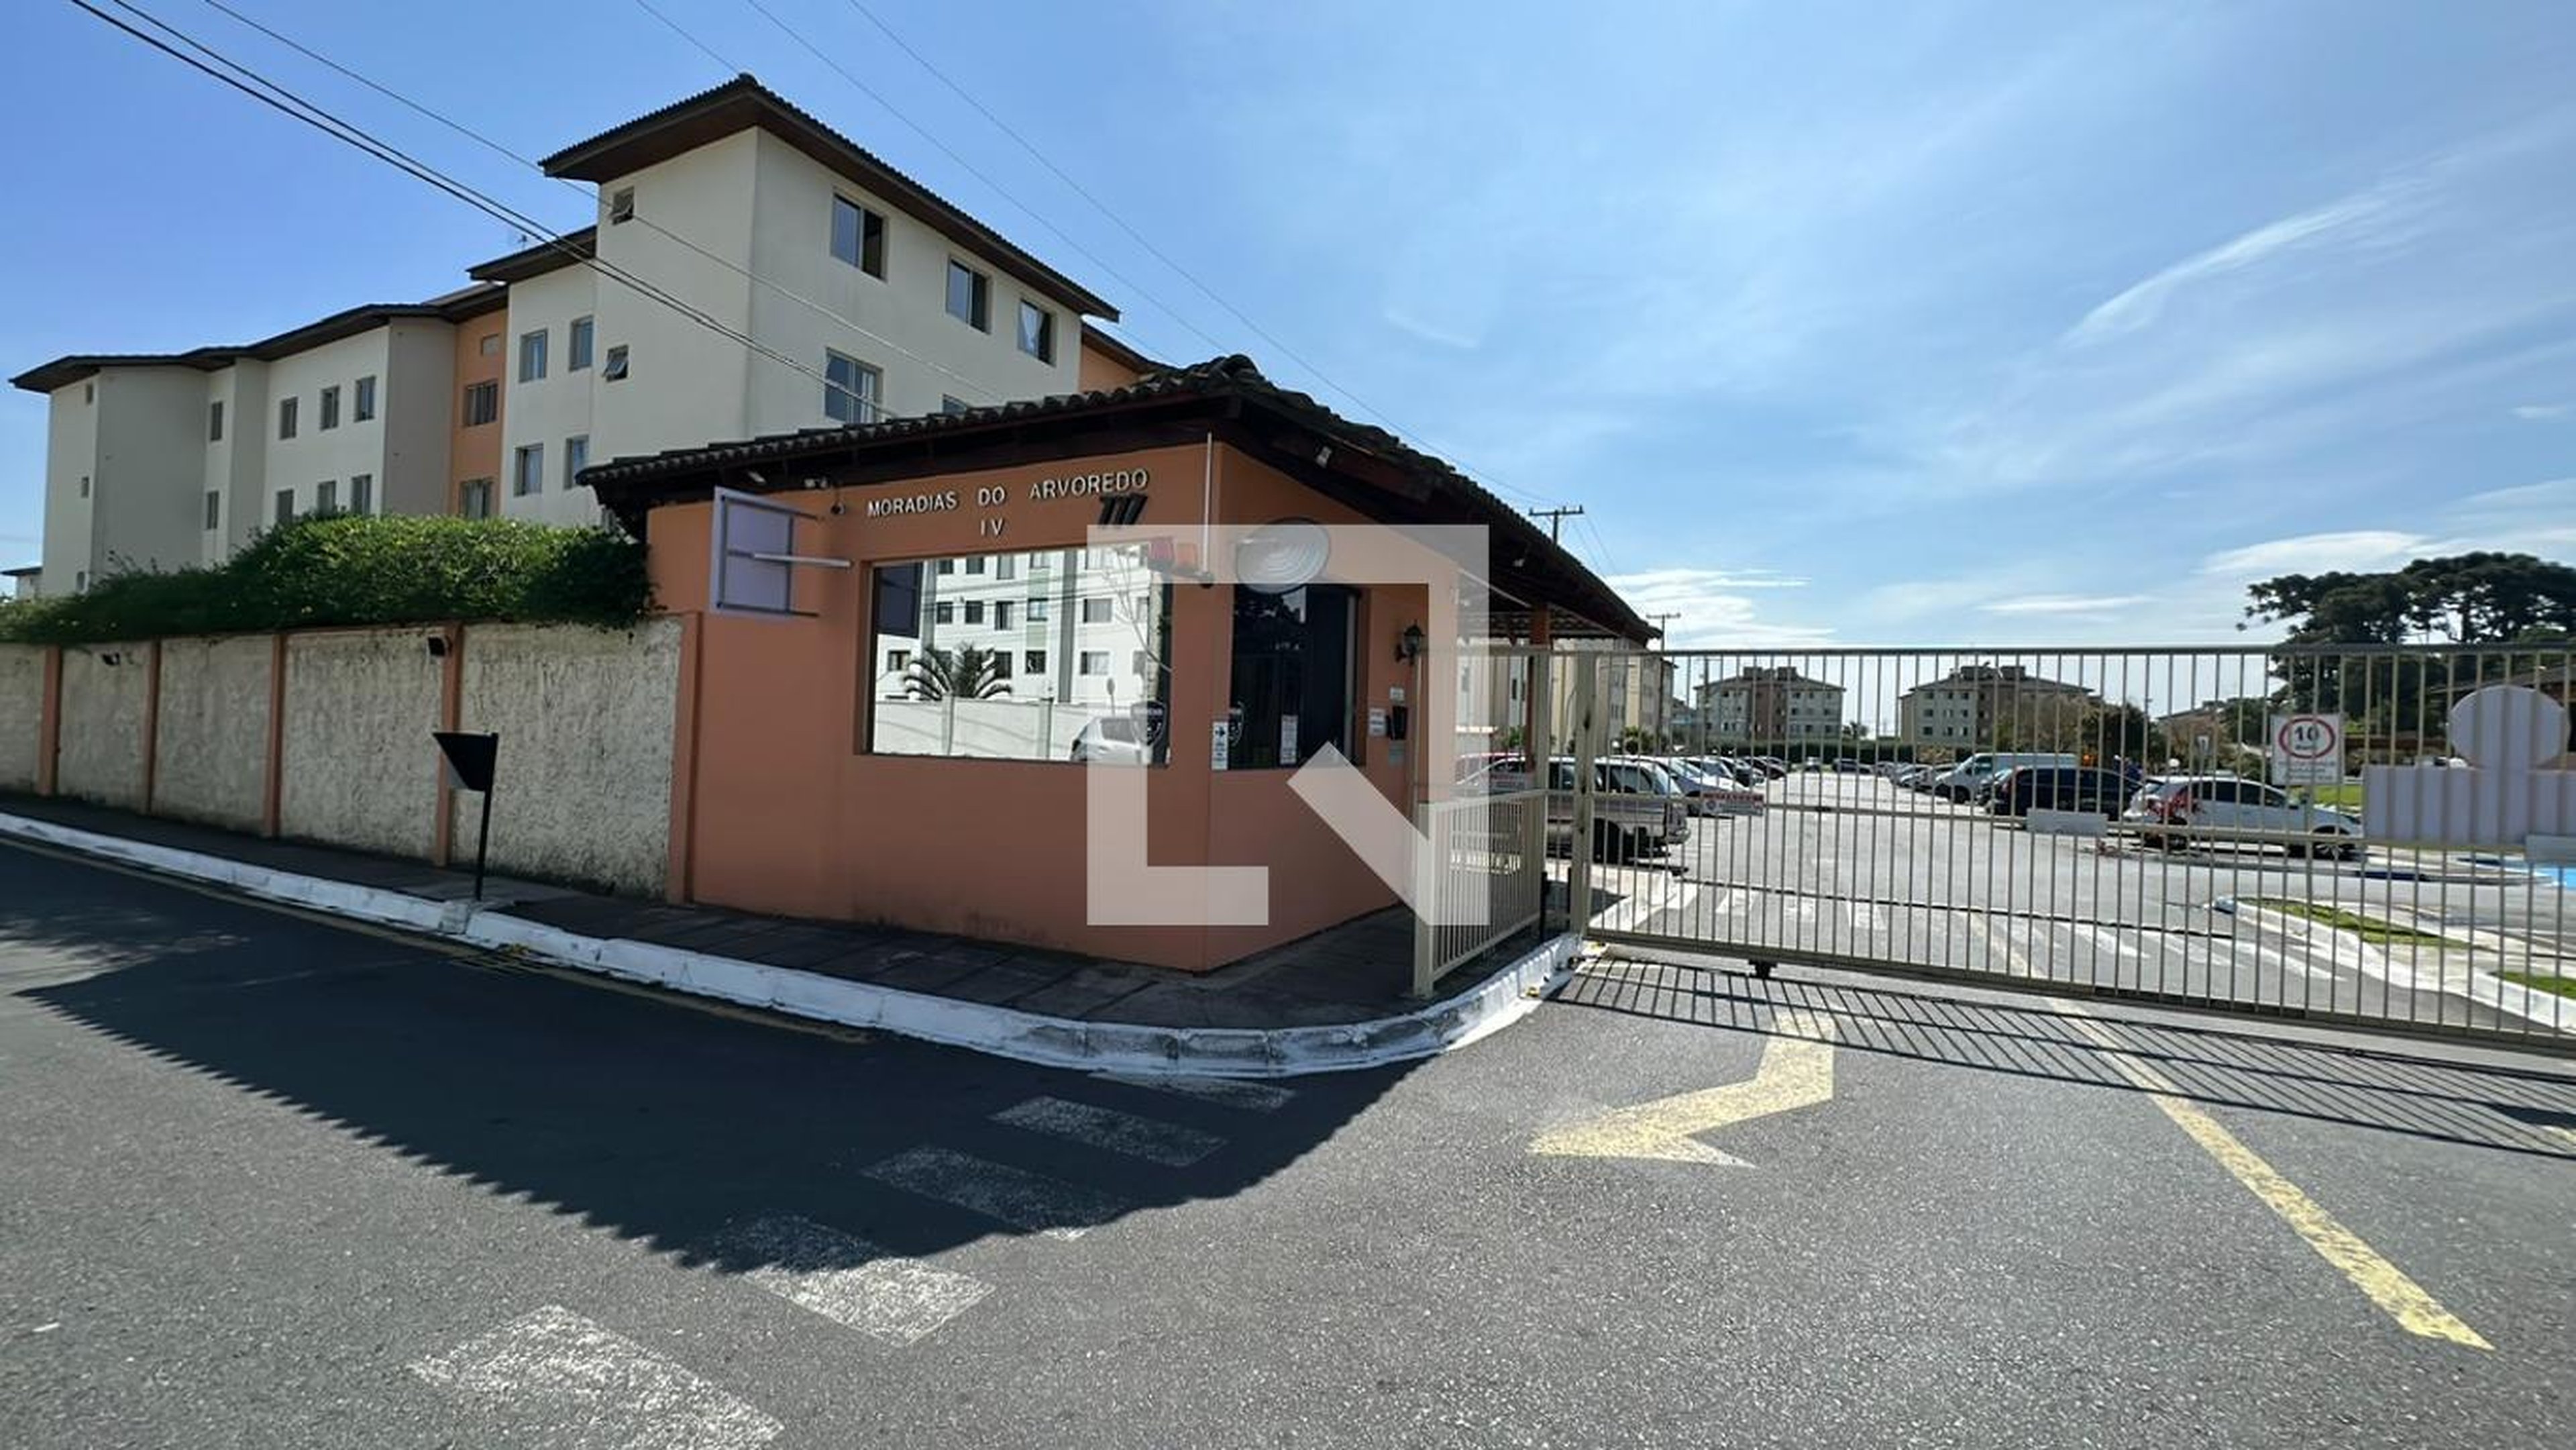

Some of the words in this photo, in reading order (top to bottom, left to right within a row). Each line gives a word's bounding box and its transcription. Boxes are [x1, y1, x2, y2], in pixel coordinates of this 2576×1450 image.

[867, 490, 958, 518] MORADIAS
[978, 486, 1006, 506] DO
[1028, 468, 1148, 499] ARVOREDO
[2294, 726, 2320, 741] 10
